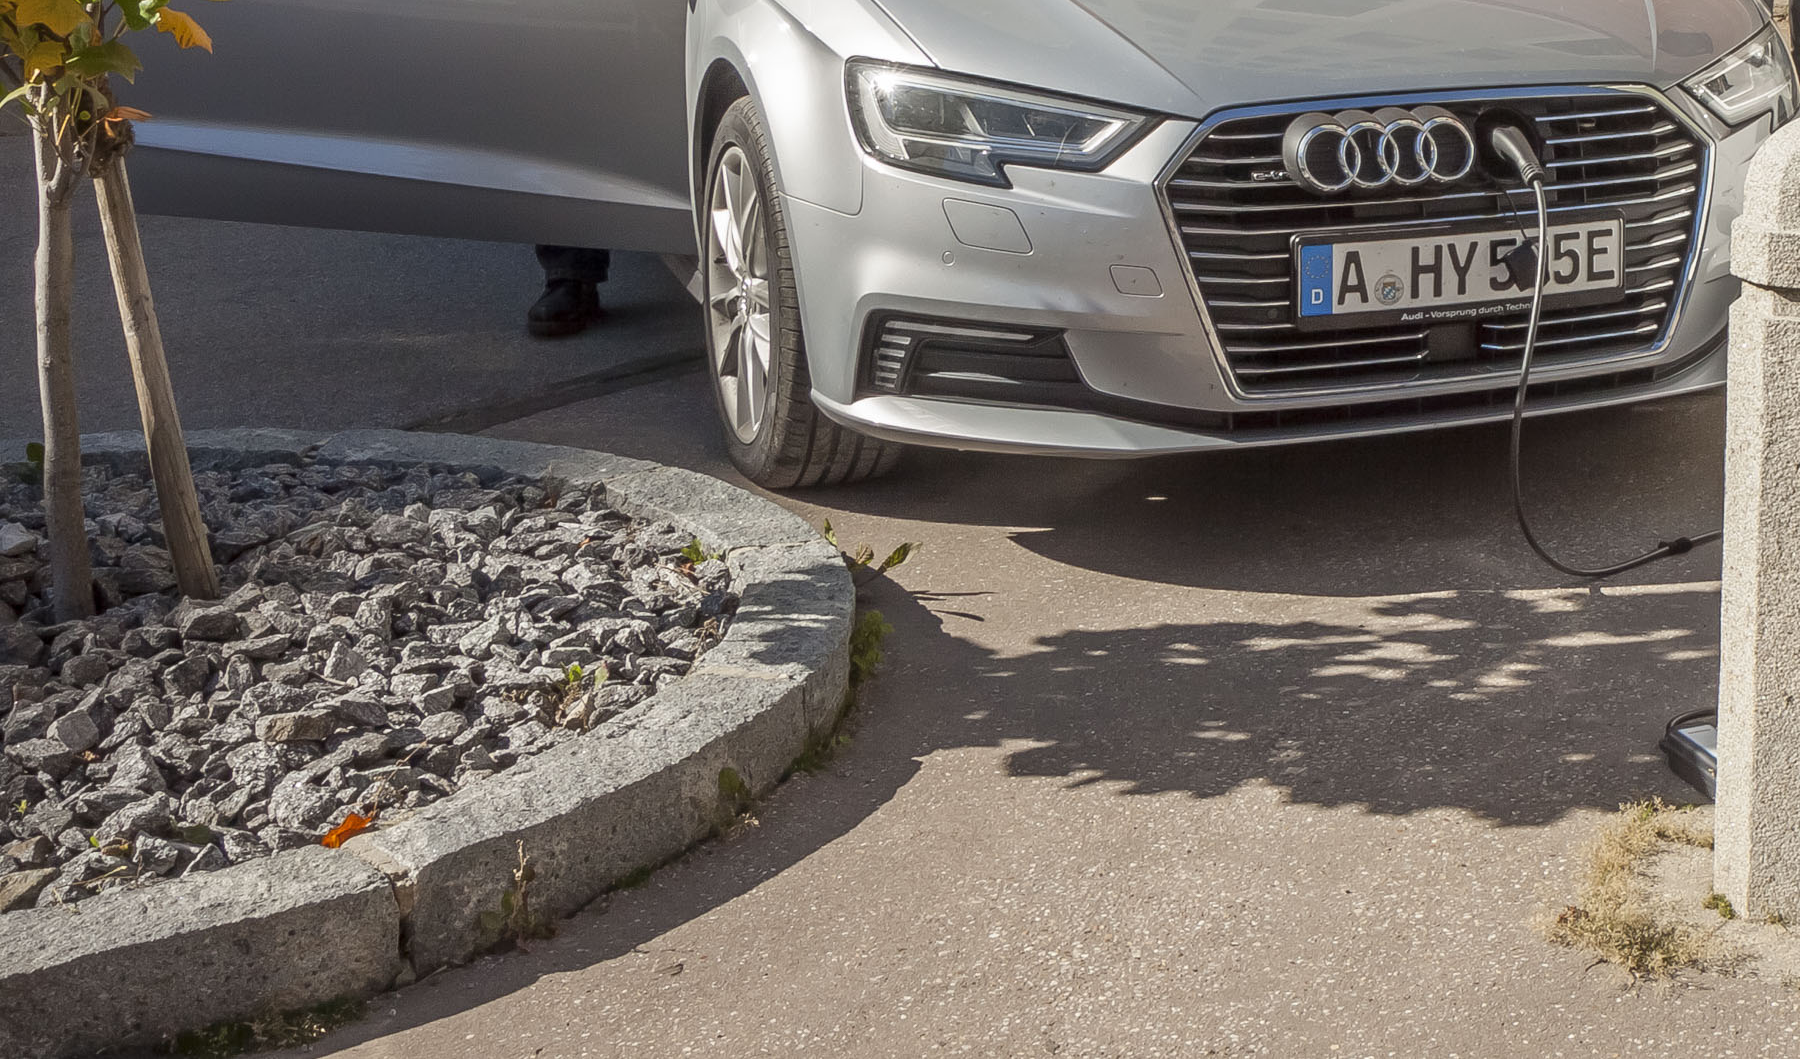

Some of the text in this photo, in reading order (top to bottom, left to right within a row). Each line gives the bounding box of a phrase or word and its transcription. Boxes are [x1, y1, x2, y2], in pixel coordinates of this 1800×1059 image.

[1311, 228, 1616, 306] D A HY 55E
[1400, 312, 1424, 321] Audi
[1430, 307, 1477, 319] Vorsprung
[1478, 305, 1504, 315] durch
[1505, 302, 1534, 311] Techni
